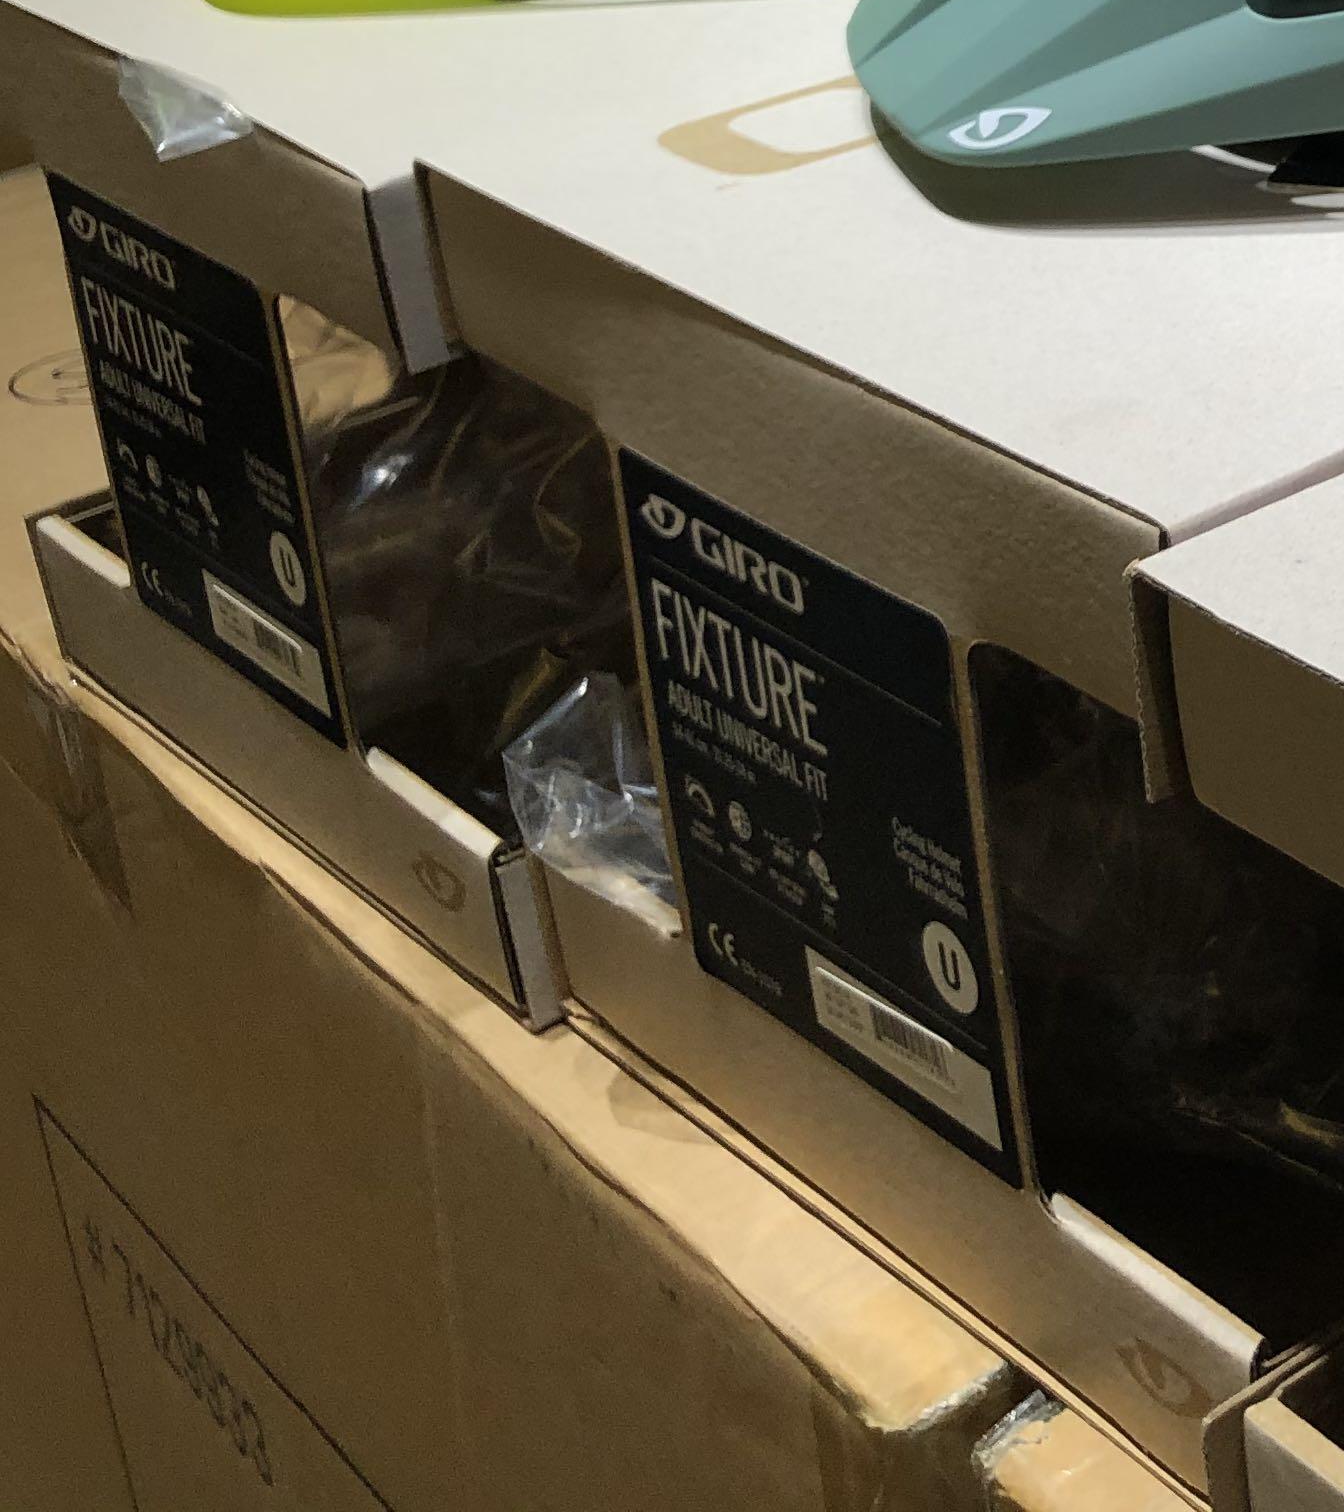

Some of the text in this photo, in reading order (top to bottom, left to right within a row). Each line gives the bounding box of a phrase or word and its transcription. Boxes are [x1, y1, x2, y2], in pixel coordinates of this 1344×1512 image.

[101, 227, 177, 290] GIRO
[80, 275, 203, 407] FIXTURE
[690, 518, 805, 616] GIRO
[651, 578, 829, 758] FIXTURE
[717, 706, 803, 788] UNIVERSAL
[800, 766, 829, 802] FIT
